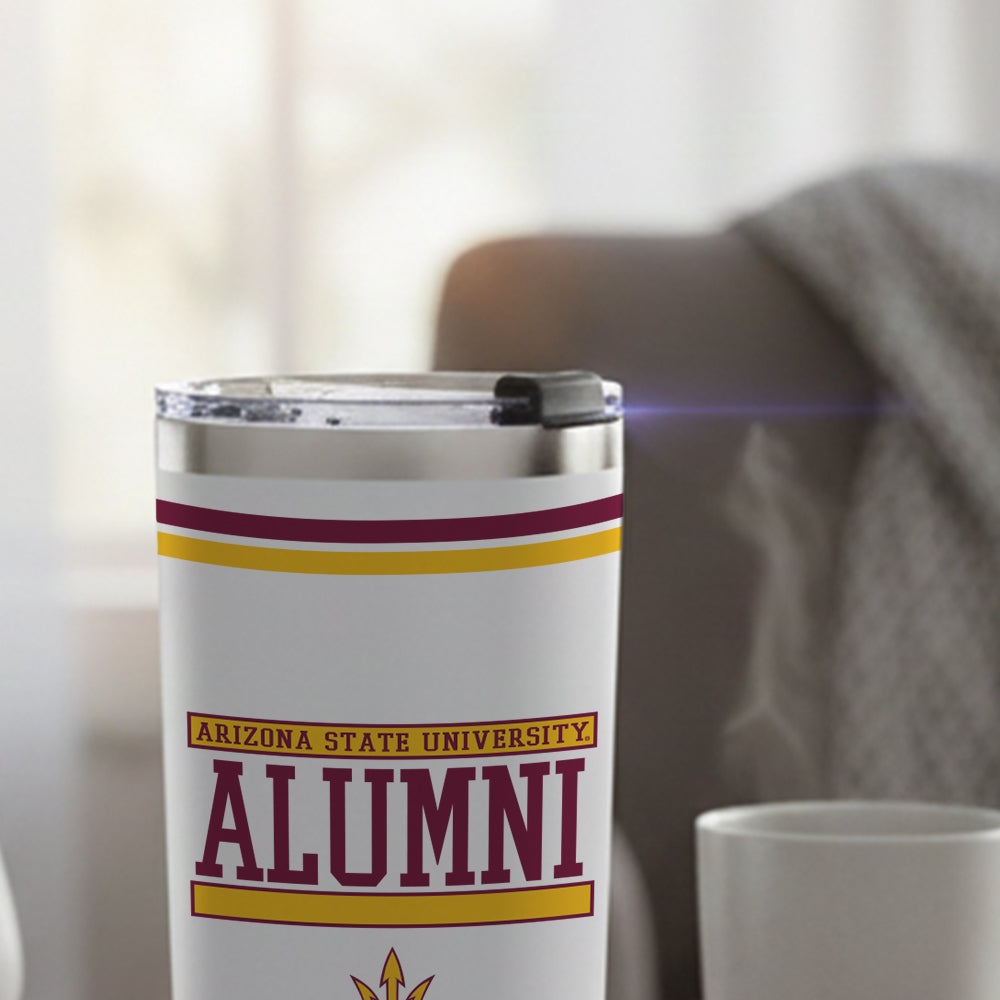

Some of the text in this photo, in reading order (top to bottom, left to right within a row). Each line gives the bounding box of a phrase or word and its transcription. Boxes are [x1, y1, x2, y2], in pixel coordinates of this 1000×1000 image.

[196, 721, 590, 753] ARIZONA STATE UNIVERSITY
[195, 757, 586, 888] ALUMNI
